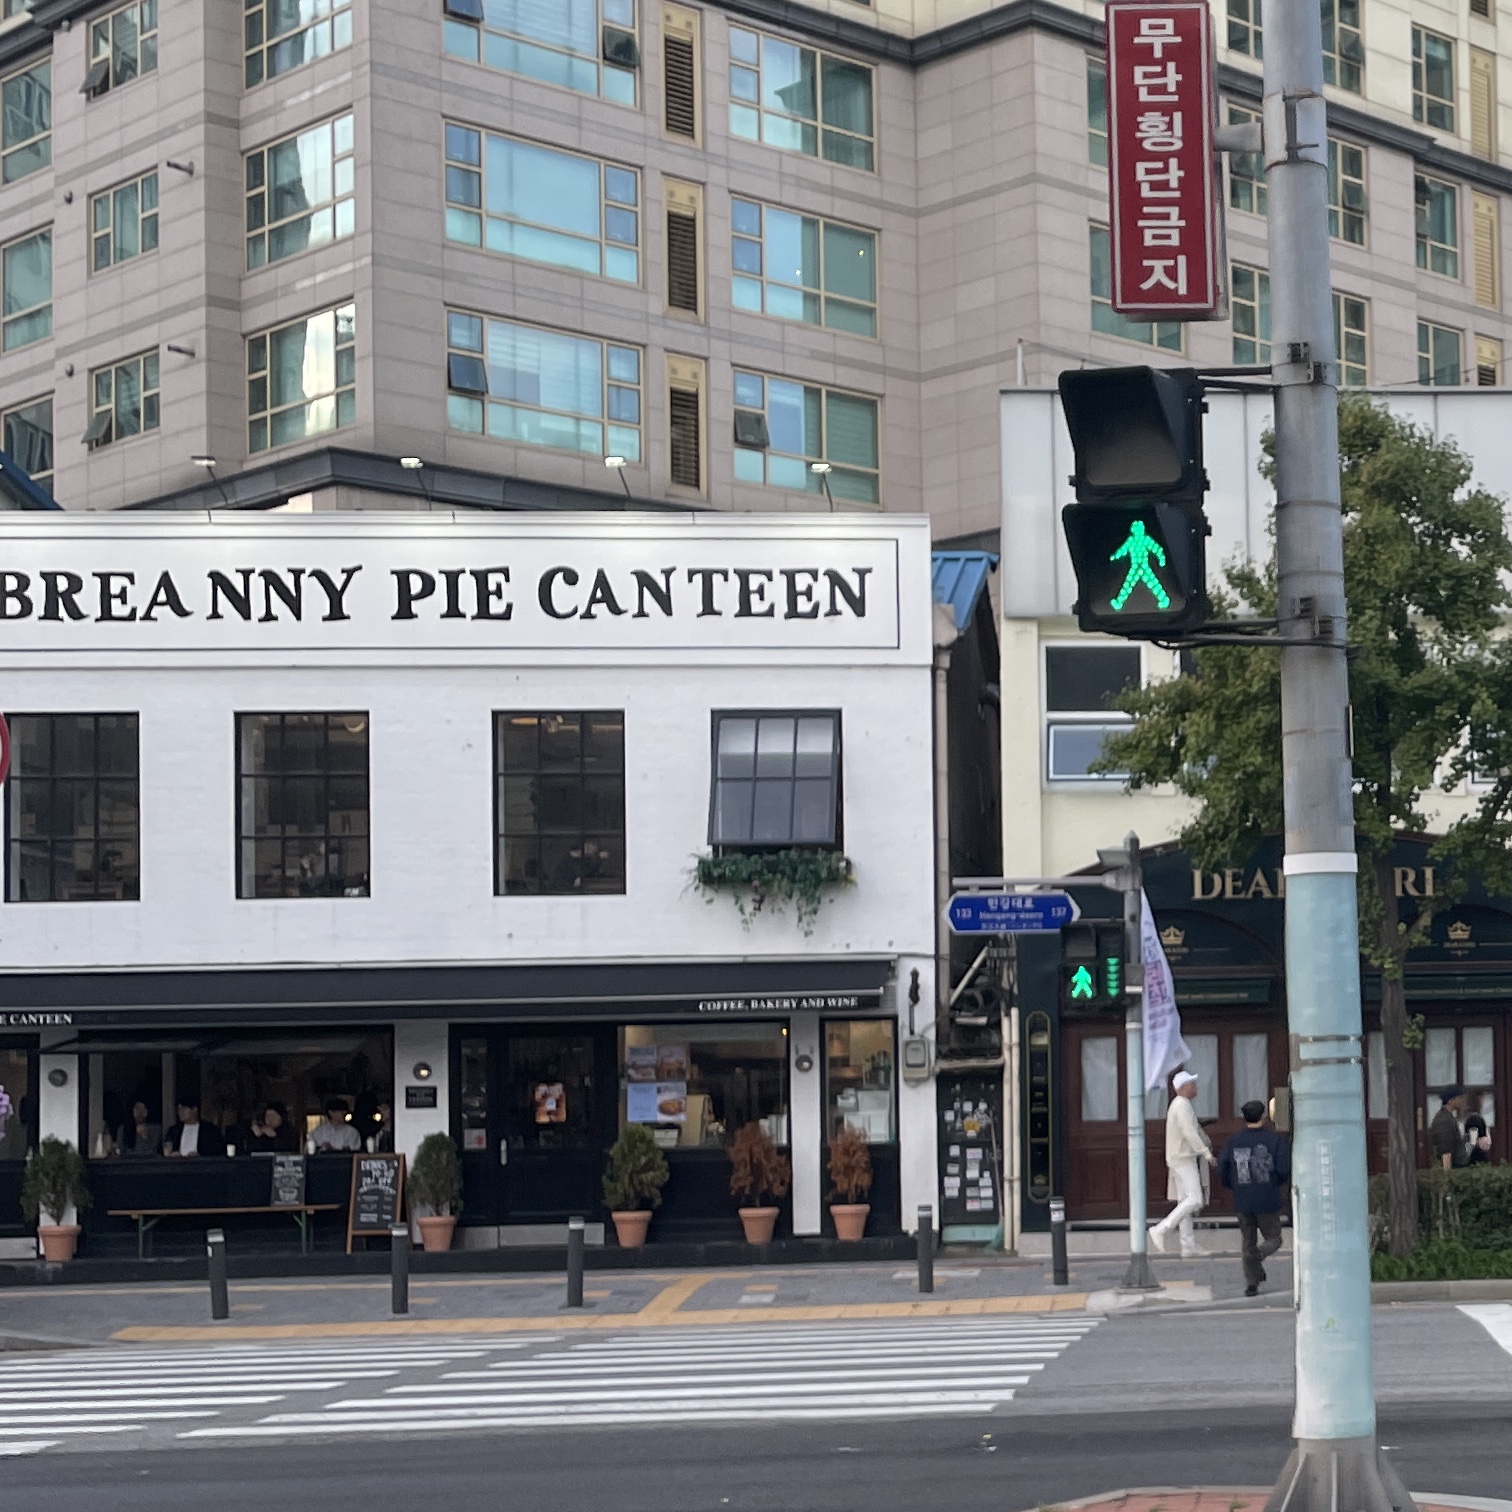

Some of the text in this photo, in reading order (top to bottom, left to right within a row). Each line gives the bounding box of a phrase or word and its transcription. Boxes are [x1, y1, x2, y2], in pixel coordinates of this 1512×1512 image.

[1132, 17, 1188, 297] 무단횡단금지
[0, 564, 874, 623] BREANNY PIE CANTEEN
[1191, 866, 1286, 900] DEA
[986, 896, 1035, 912] 한강대로
[750, 998, 798, 1010] BAKERY
[799, 997, 825, 1009] AND
[827, 996, 859, 1008] WINE
[9, 1012, 73, 1025] CANTEEN
